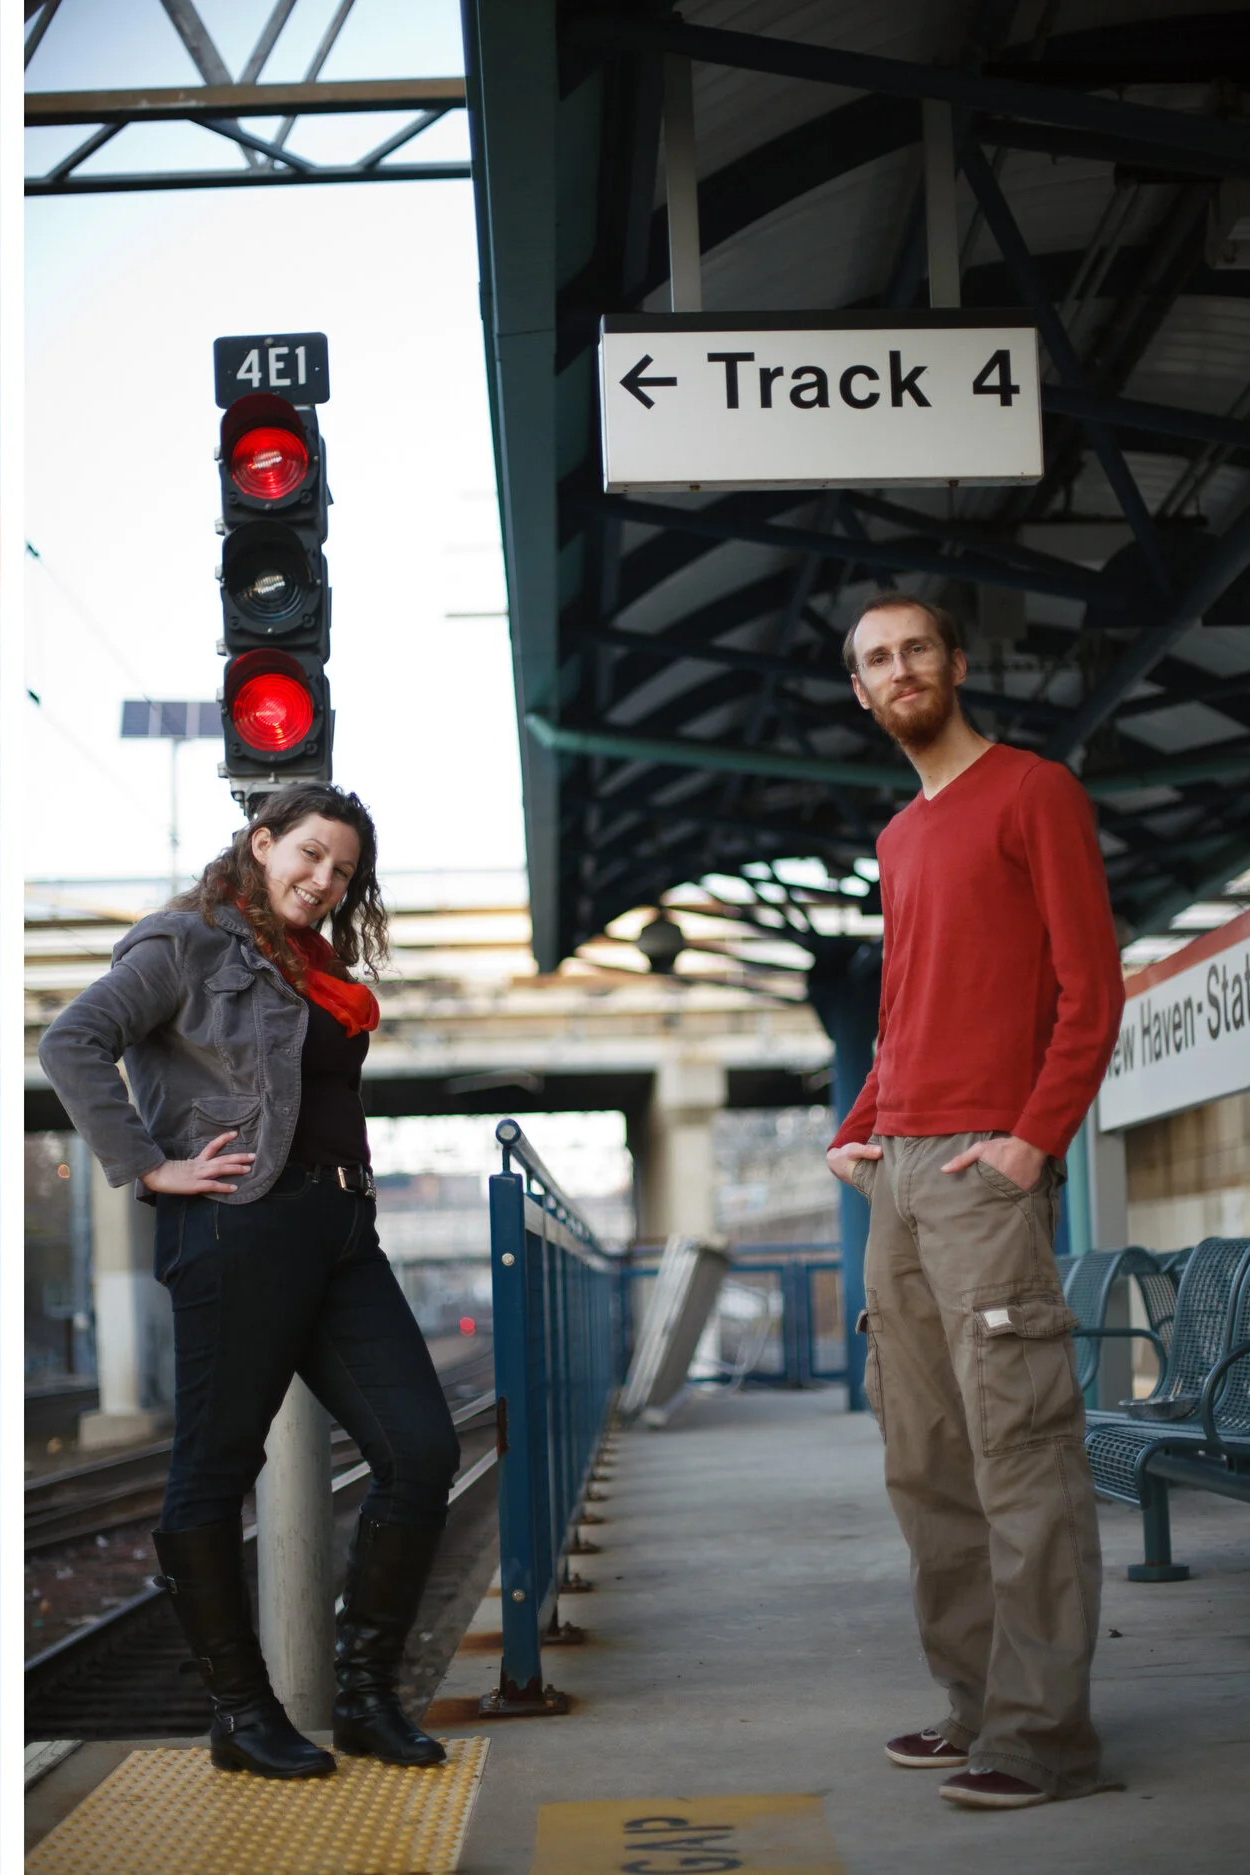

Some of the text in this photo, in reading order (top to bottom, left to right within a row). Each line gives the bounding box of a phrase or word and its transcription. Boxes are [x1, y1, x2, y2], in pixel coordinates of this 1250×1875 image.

[236, 346, 307, 388] 4E1
[707, 349, 1021, 410] Track 4
[1108, 1023, 1136, 1079] ew
